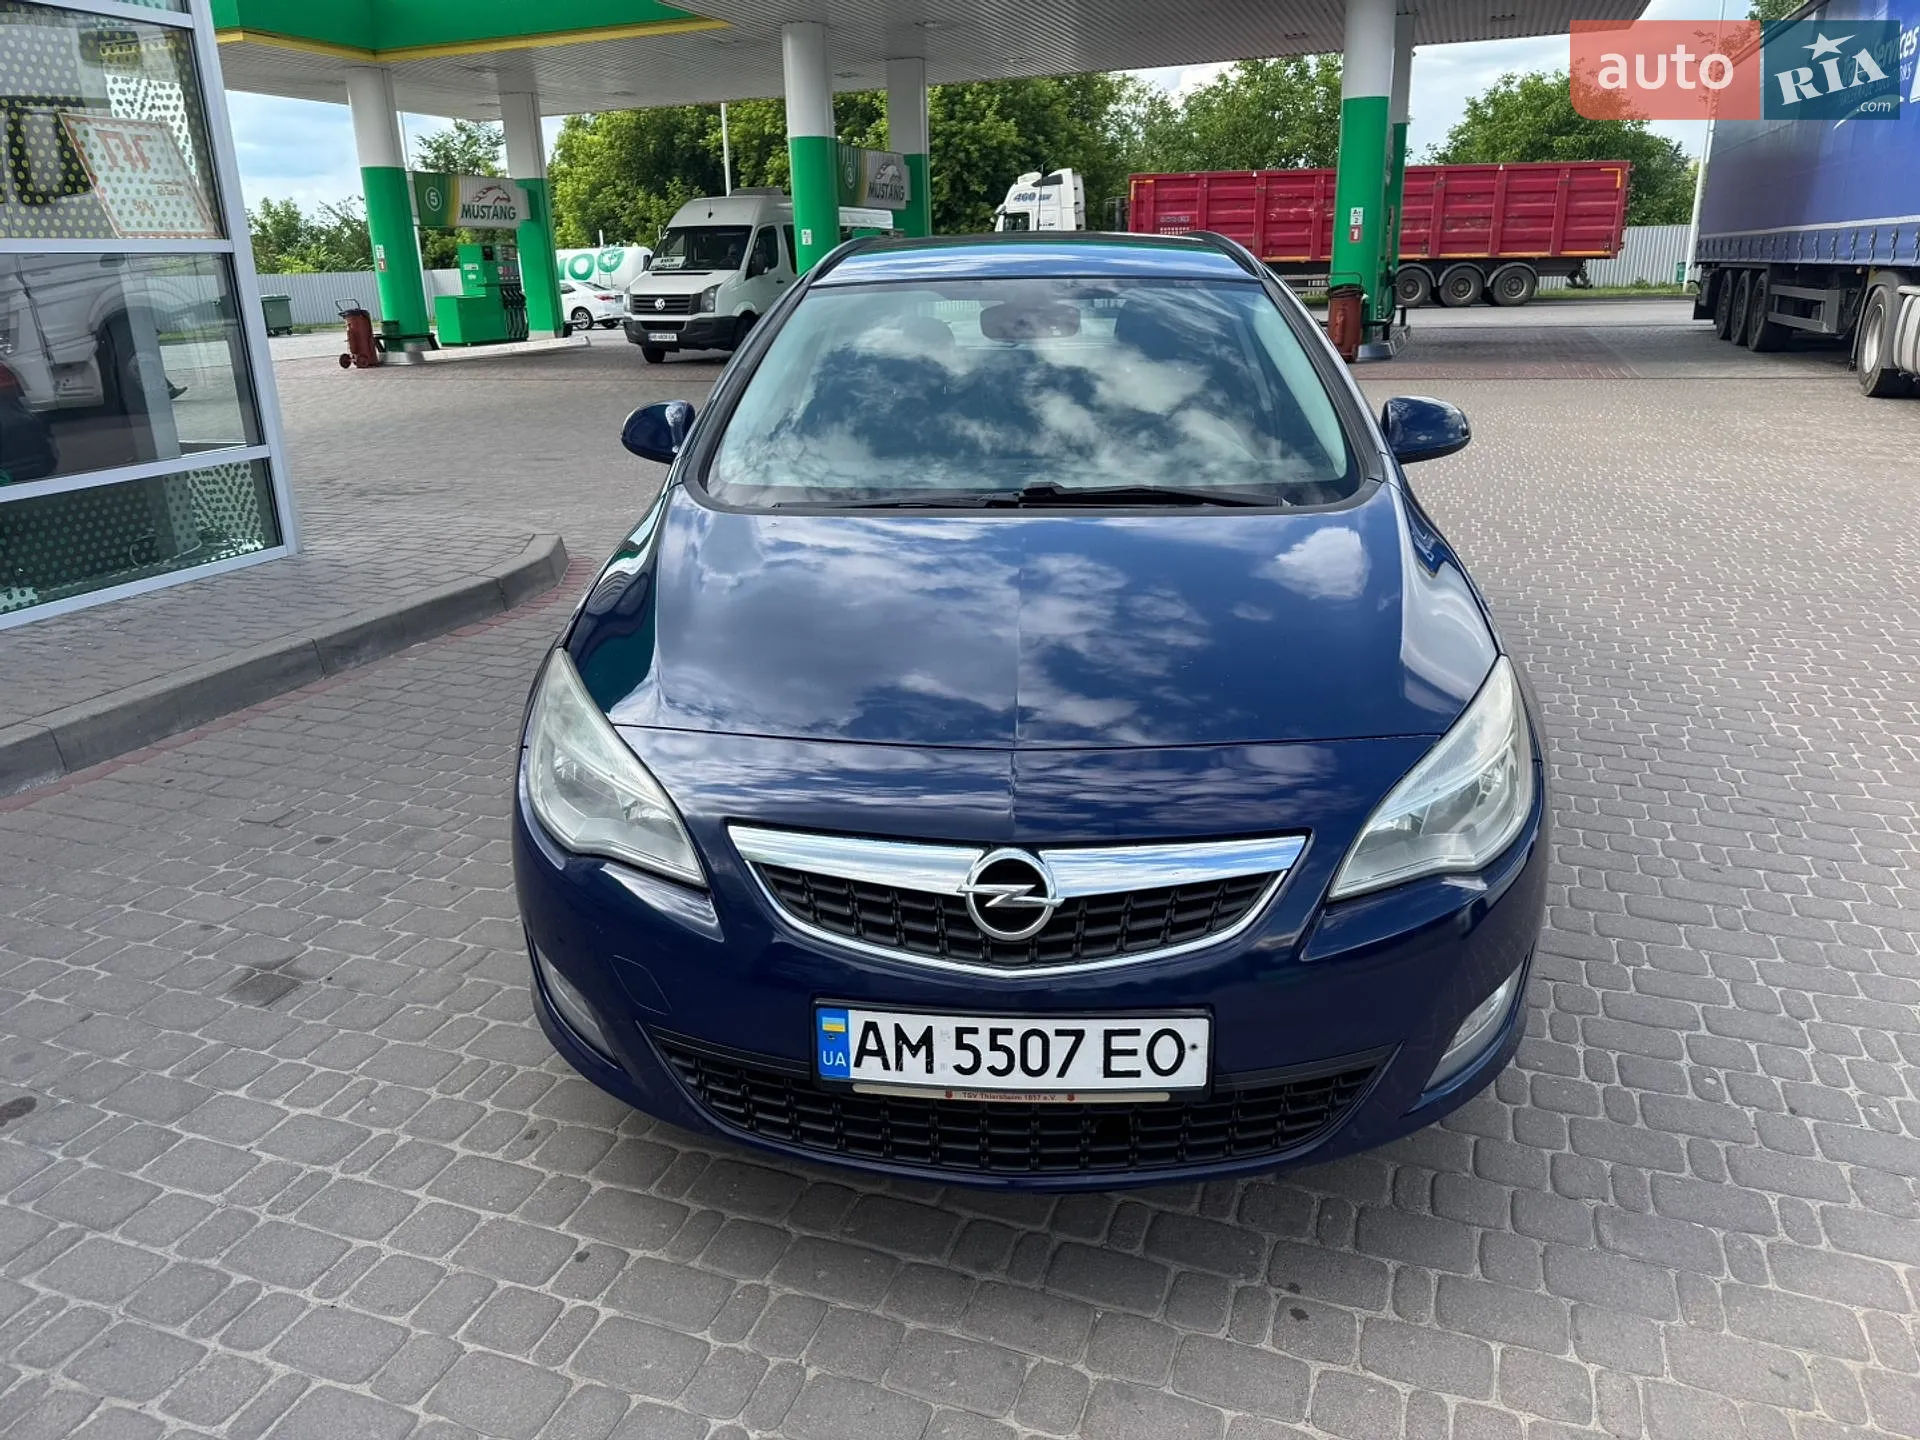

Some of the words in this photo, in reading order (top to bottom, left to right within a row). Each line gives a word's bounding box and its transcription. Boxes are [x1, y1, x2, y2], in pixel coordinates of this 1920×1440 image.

[868, 181, 905, 202] MUSTANG
[460, 203, 517, 221] MUSTANG
[822, 1049, 847, 1069] UA
[852, 1020, 934, 1075] AM
[952, 1026, 1085, 1079] 5507
[1103, 1027, 1187, 1080] EO
